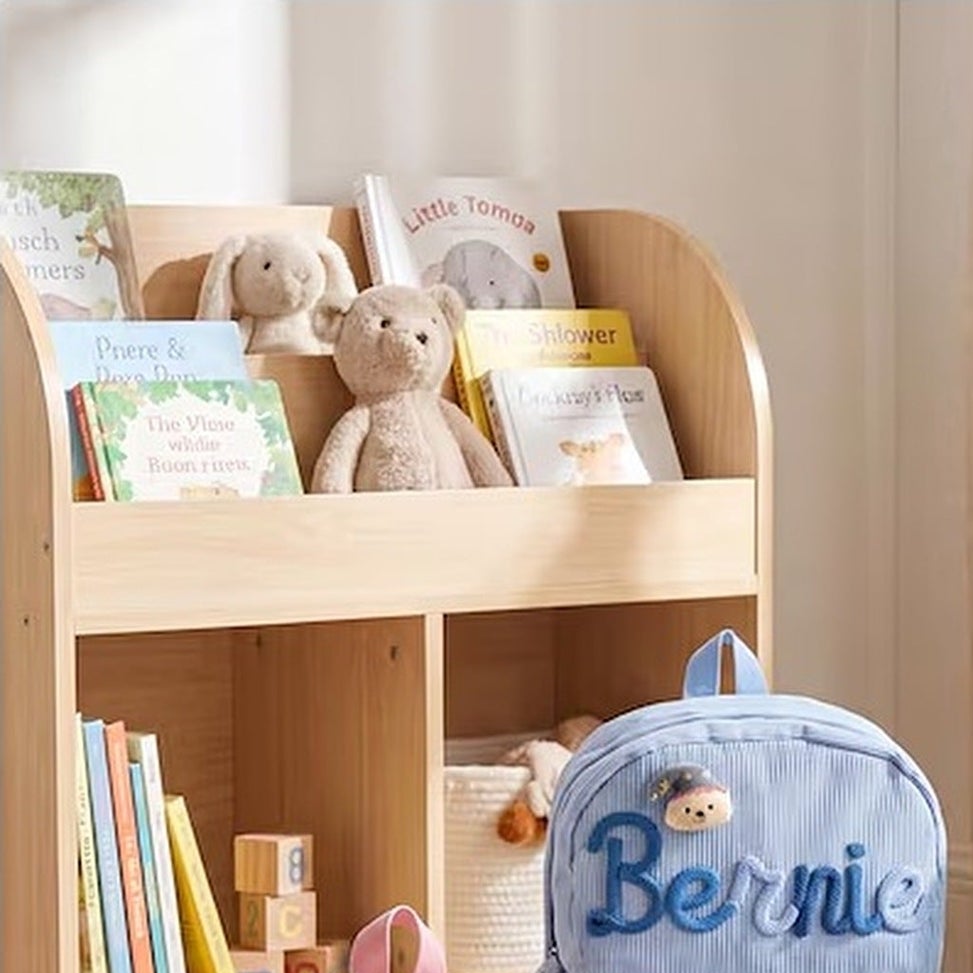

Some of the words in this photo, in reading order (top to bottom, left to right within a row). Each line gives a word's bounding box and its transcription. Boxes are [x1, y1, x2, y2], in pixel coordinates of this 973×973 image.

[402, 199, 458, 234] Little
[167, 337, 186, 360] &
[586, 811, 927, 940] Bernie
